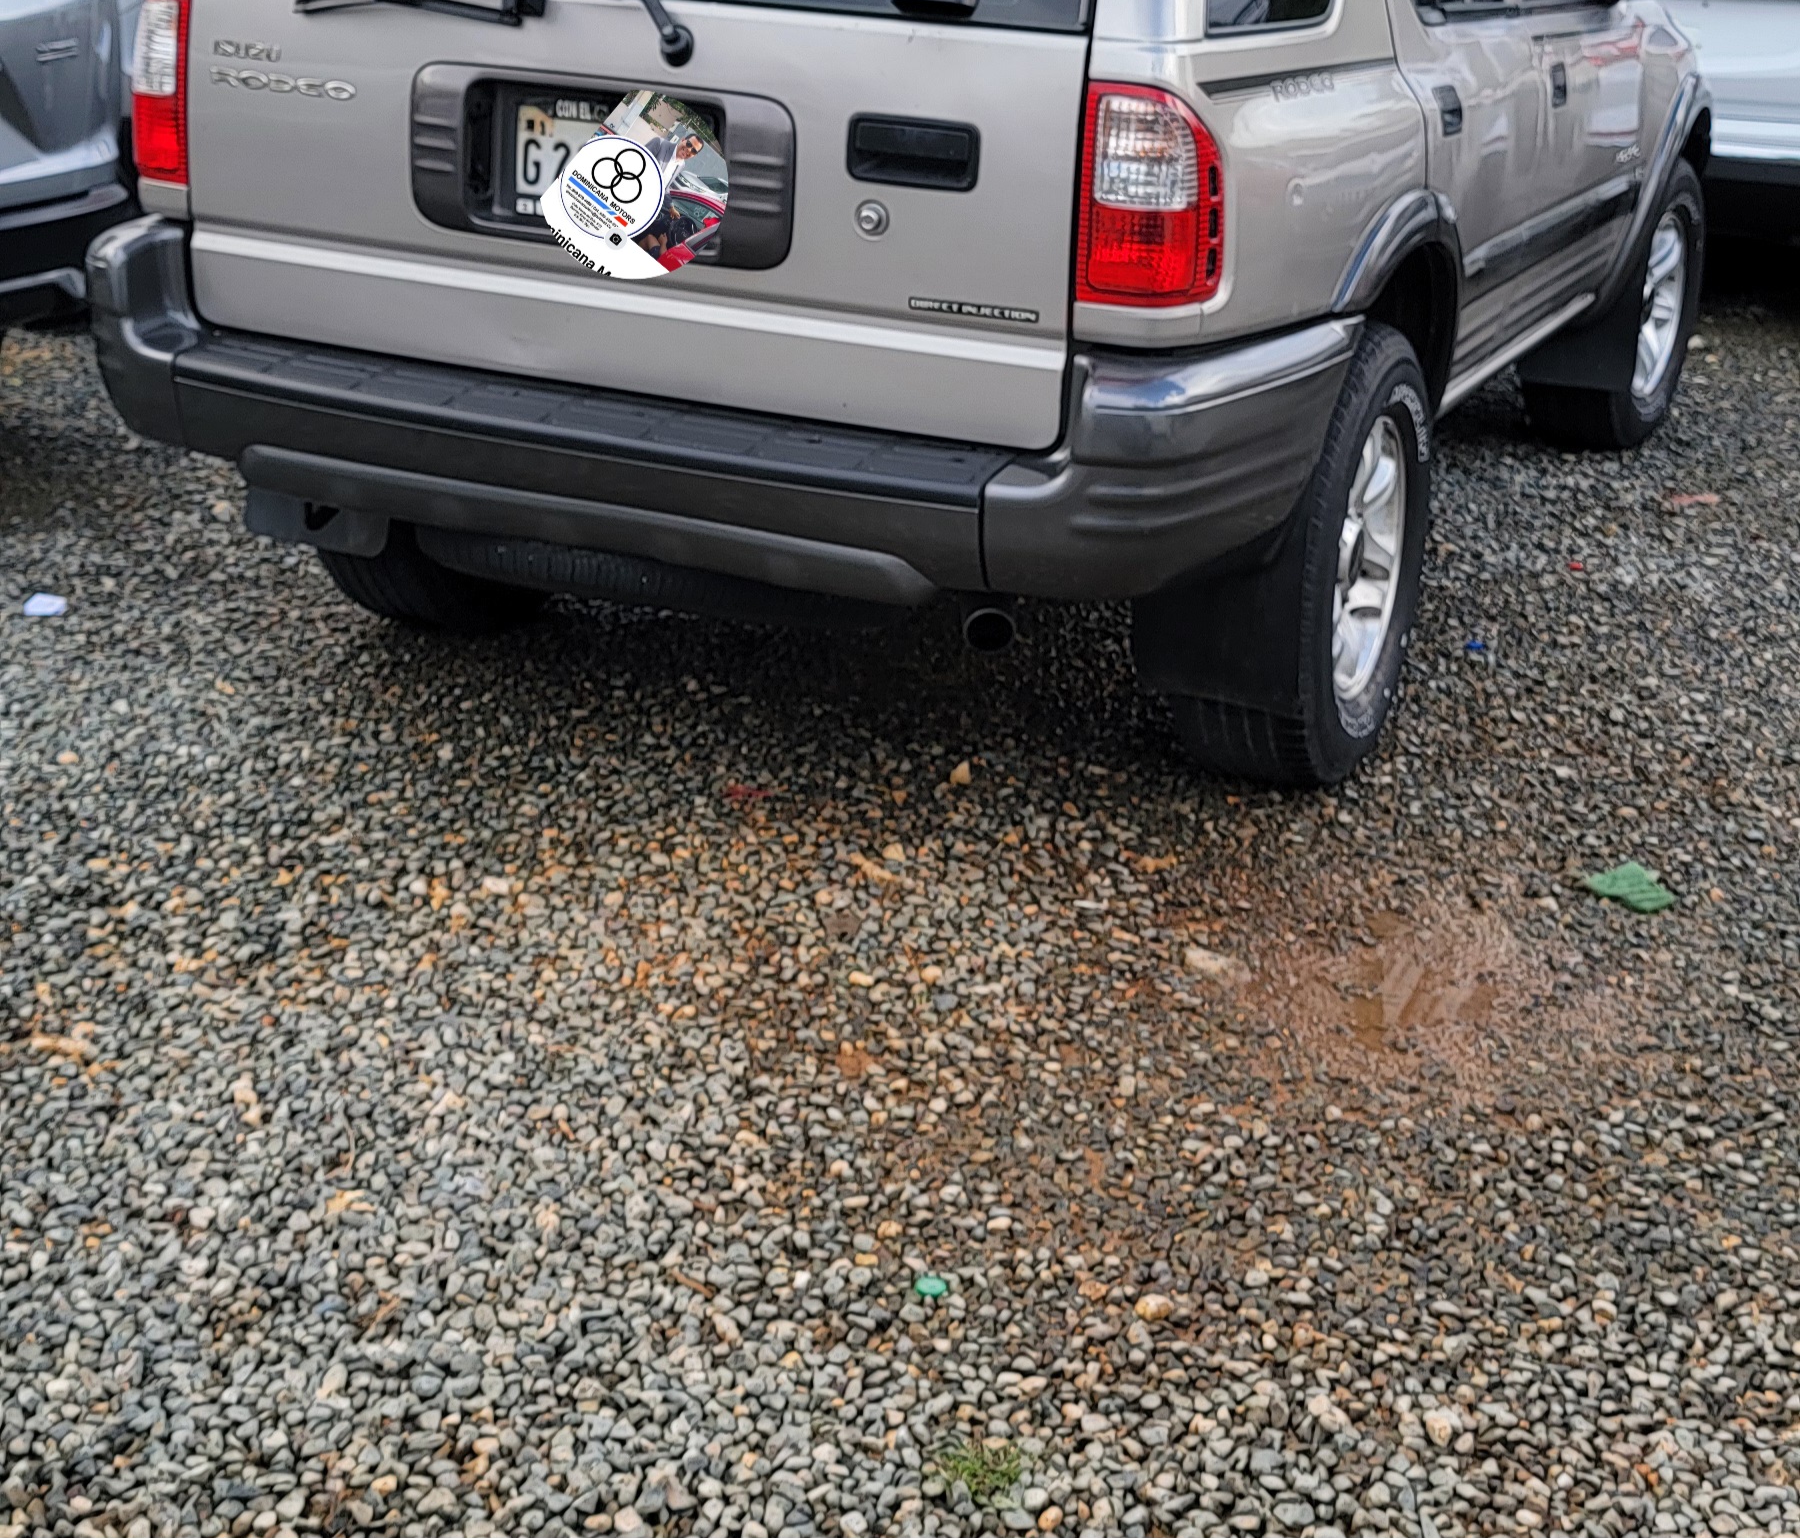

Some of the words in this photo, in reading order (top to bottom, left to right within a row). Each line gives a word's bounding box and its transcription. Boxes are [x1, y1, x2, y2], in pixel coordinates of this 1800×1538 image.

[213, 39, 282, 62] ISUZU
[210, 65, 357, 102] RODEO
[523, 139, 582, 186] G2
[910, 298, 959, 313] DIRECT
[961, 304, 1037, 322] INJECTION
